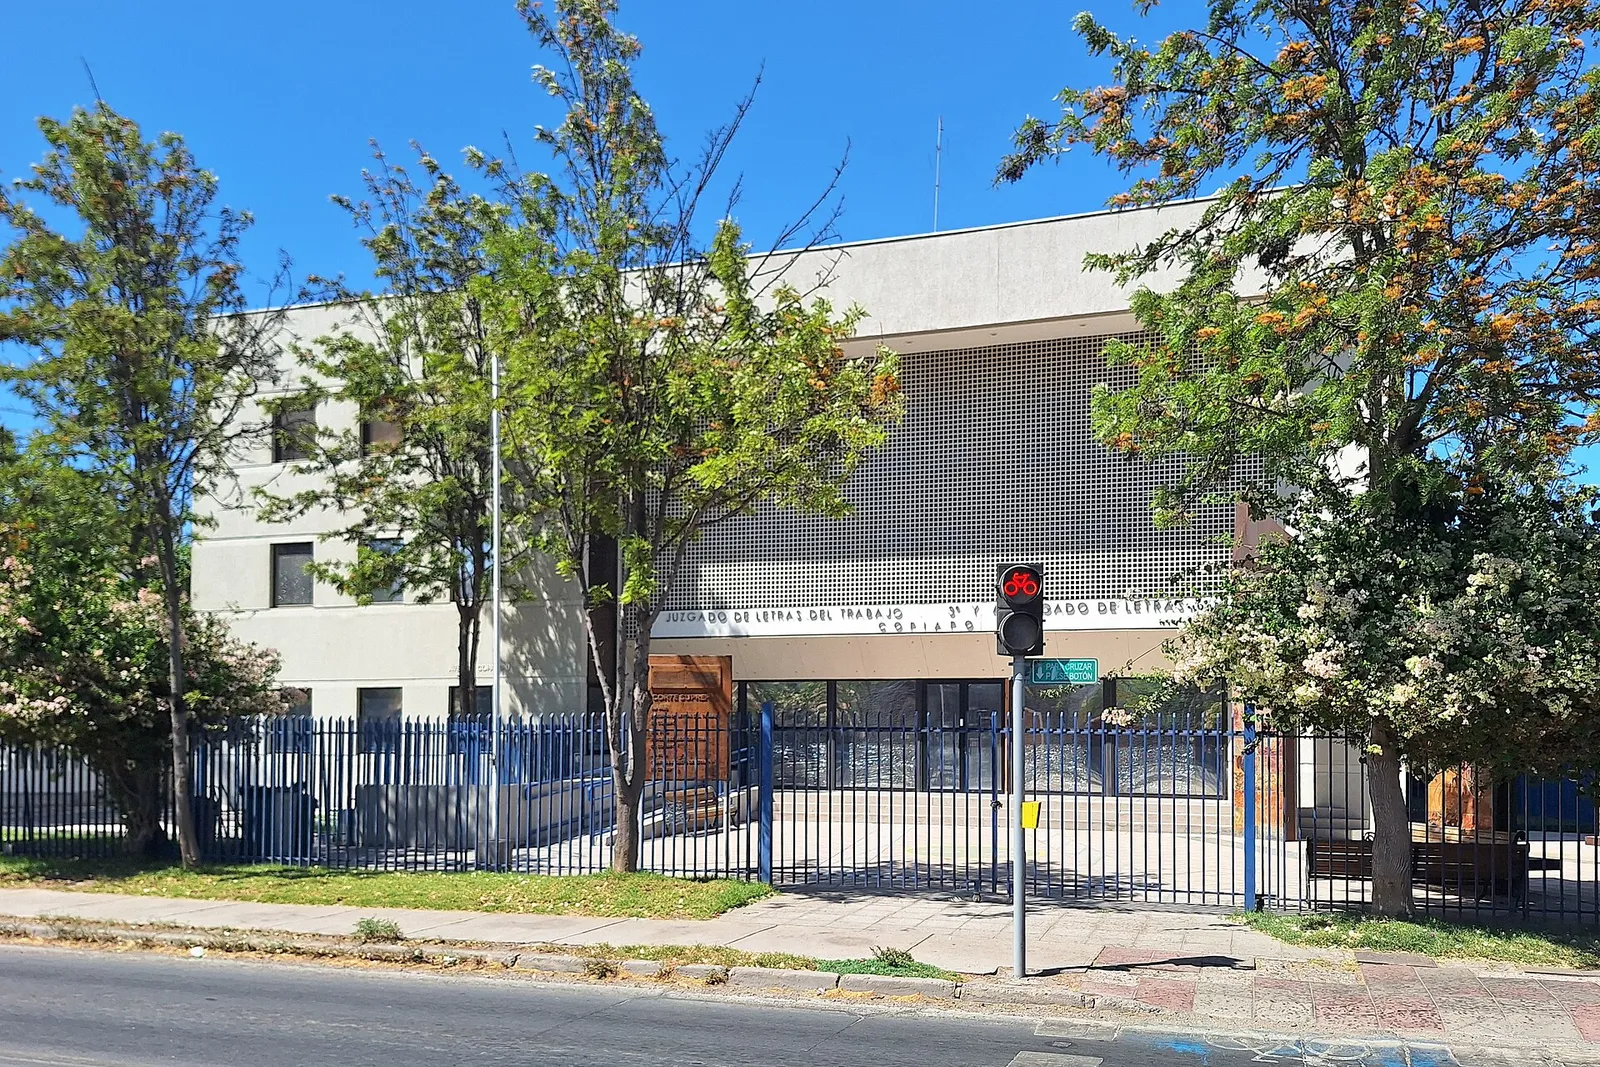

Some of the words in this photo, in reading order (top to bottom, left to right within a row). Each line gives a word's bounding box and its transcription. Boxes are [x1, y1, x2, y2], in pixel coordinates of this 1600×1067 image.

[1043, 602, 1089, 616] GADO
[1097, 602, 1117, 615] DE
[666, 611, 728, 624] JUZGADO
[734, 611, 750, 623] DE
[756, 610, 803, 623] LETRAS
[809, 609, 833, 621] DEL
[840, 607, 904, 620] TRABAJO
[1065, 662, 1092, 671] CRUZAR
[1046, 672, 1068, 680] PLSE
[1069, 671, 1093, 680] BOTÓN
[679, 693, 713, 702] SUPRE
